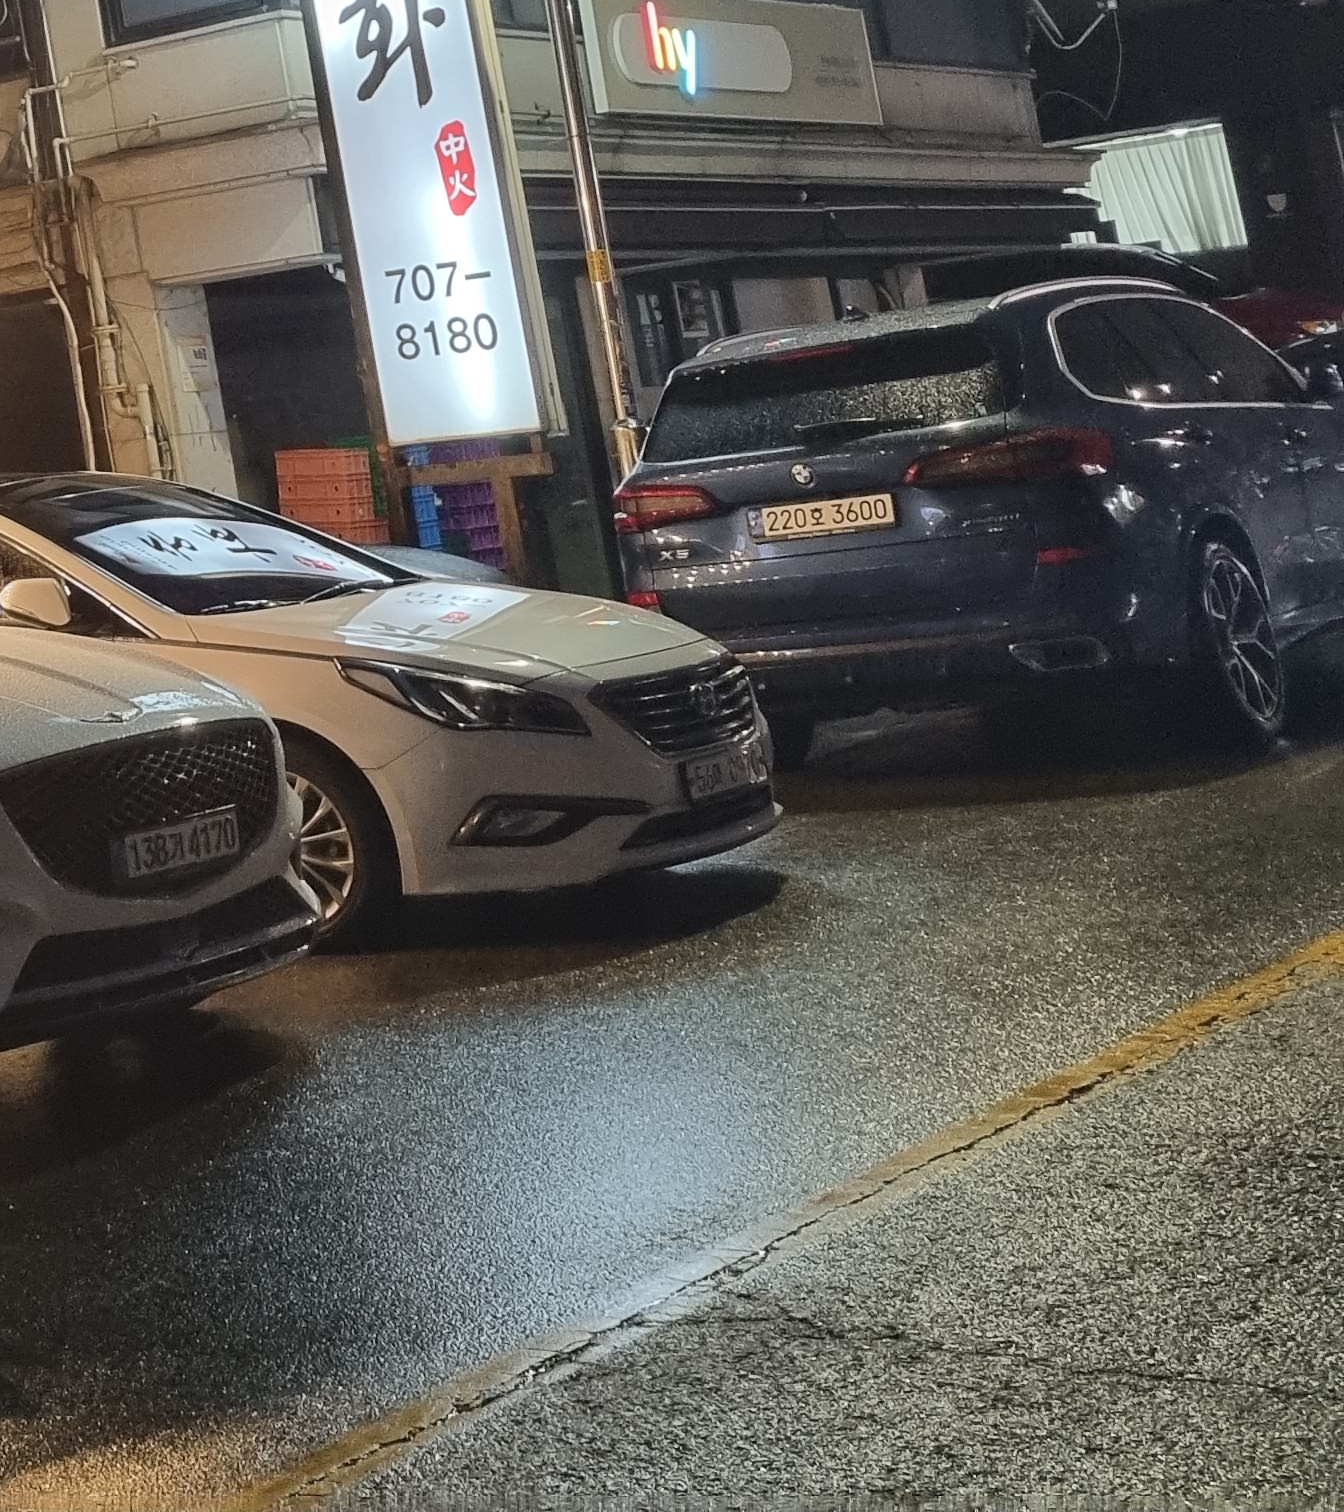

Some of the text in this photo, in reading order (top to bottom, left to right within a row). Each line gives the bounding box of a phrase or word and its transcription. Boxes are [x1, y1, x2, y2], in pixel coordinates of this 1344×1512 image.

[384, 261, 491, 304] 707-
[395, 312, 498, 360] 8180
[831, 499, 887, 524] 3600
[659, 549, 690, 561] X5
